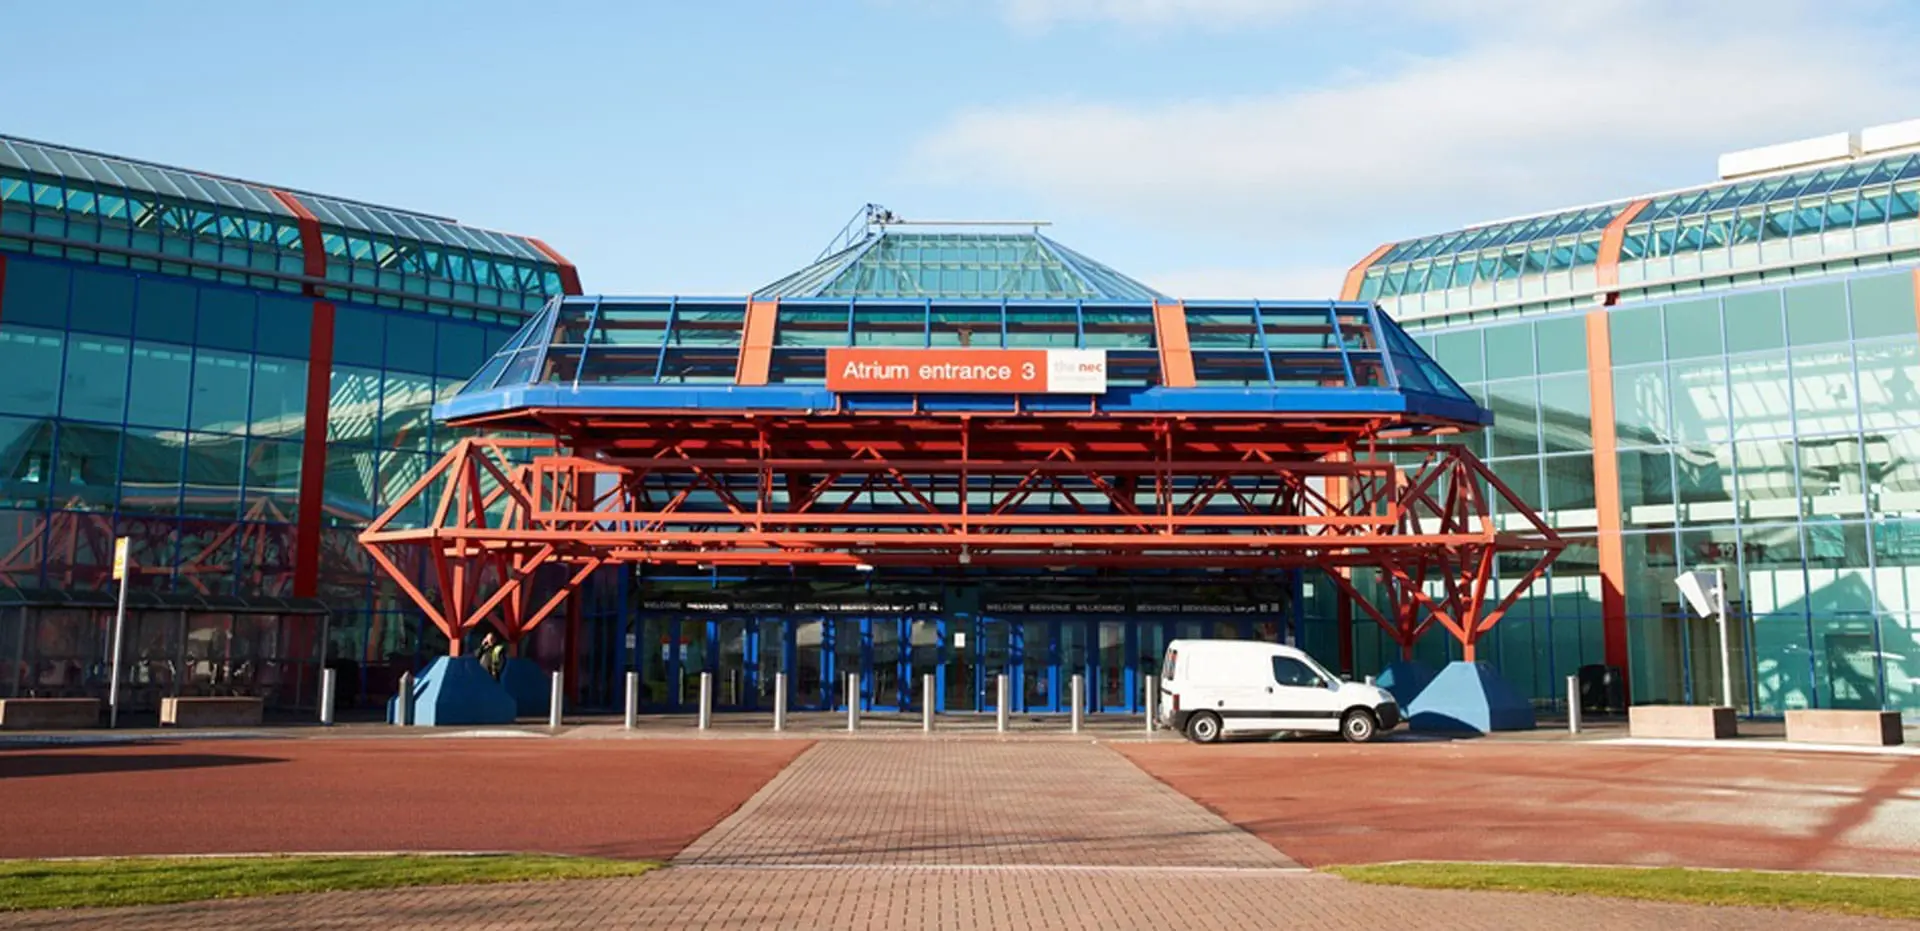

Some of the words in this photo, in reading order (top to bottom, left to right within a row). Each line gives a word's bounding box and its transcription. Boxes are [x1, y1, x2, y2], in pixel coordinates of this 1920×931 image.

[843, 361, 909, 380] Atrium
[918, 363, 1011, 380] entrance
[1021, 362, 1036, 380] 3
[1078, 363, 1103, 373] nec
[986, 603, 1024, 612] WELCOME
